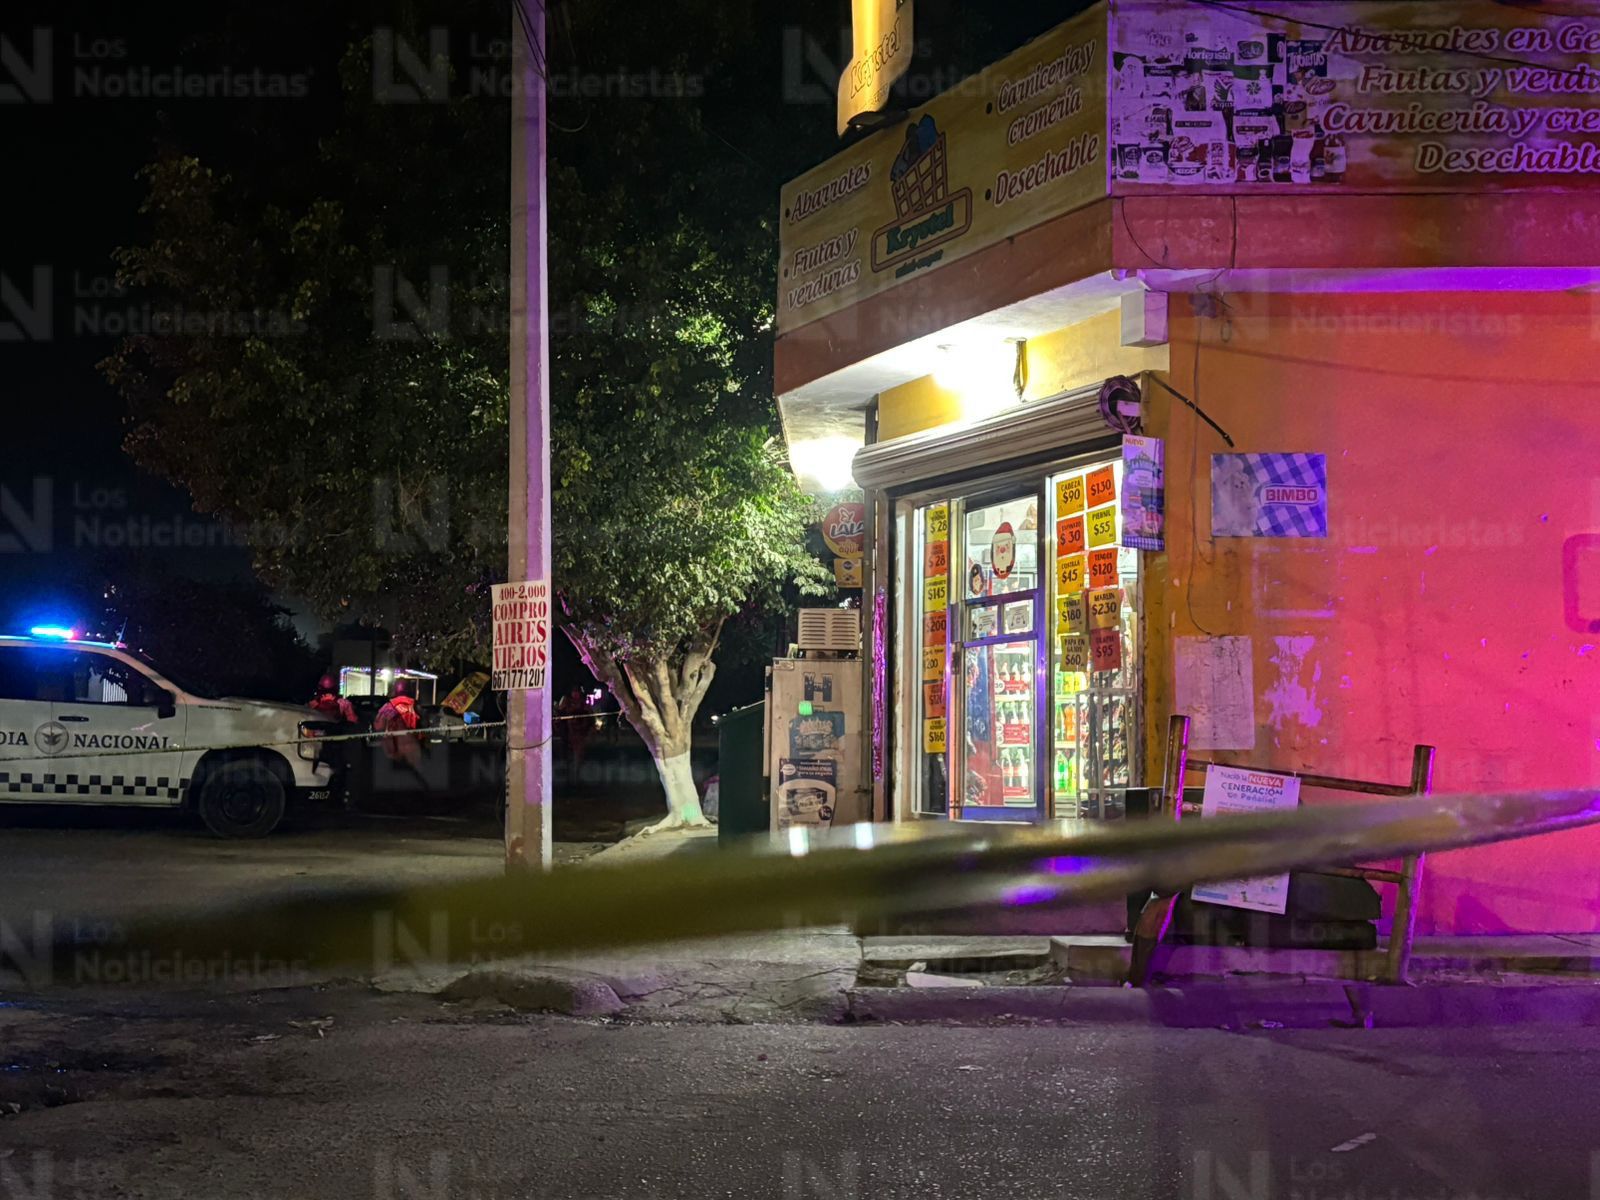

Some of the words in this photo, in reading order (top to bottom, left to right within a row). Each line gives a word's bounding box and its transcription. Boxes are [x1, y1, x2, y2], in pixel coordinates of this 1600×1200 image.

[1324, 27, 1497, 52] Abarrotes
[1507, 30, 1551, 51] en
[1360, 65, 1470, 92] Frutas
[1473, 68, 1500, 96] y
[1510, 108, 1537, 136] y
[994, 134, 1099, 206] Desechable
[791, 162, 871, 223] Abarrotes
[792, 237, 842, 279] Frutas
[842, 227, 859, 257] y
[787, 259, 860, 310] verduras
[1091, 479, 1111, 496] $130
[1265, 489, 1318, 501] BIMBO
[1063, 489, 1080, 504] $90
[1069, 530, 1080, 543] 30
[1094, 521, 1110, 537] $55
[1062, 569, 1078, 583] $45
[1093, 563, 1112, 577] $120
[494, 601, 547, 621] COMPRO
[1092, 602, 1117, 616] $230
[495, 621, 547, 646] AIRES
[494, 645, 547, 669] VIEJOS
[1096, 645, 1113, 658] $95
[1065, 655, 1081, 667] $60
[493, 668, 546, 689] 6671771201
[73, 733, 171, 750] NACIONAL
[1249, 775, 1282, 786] NUEVA
